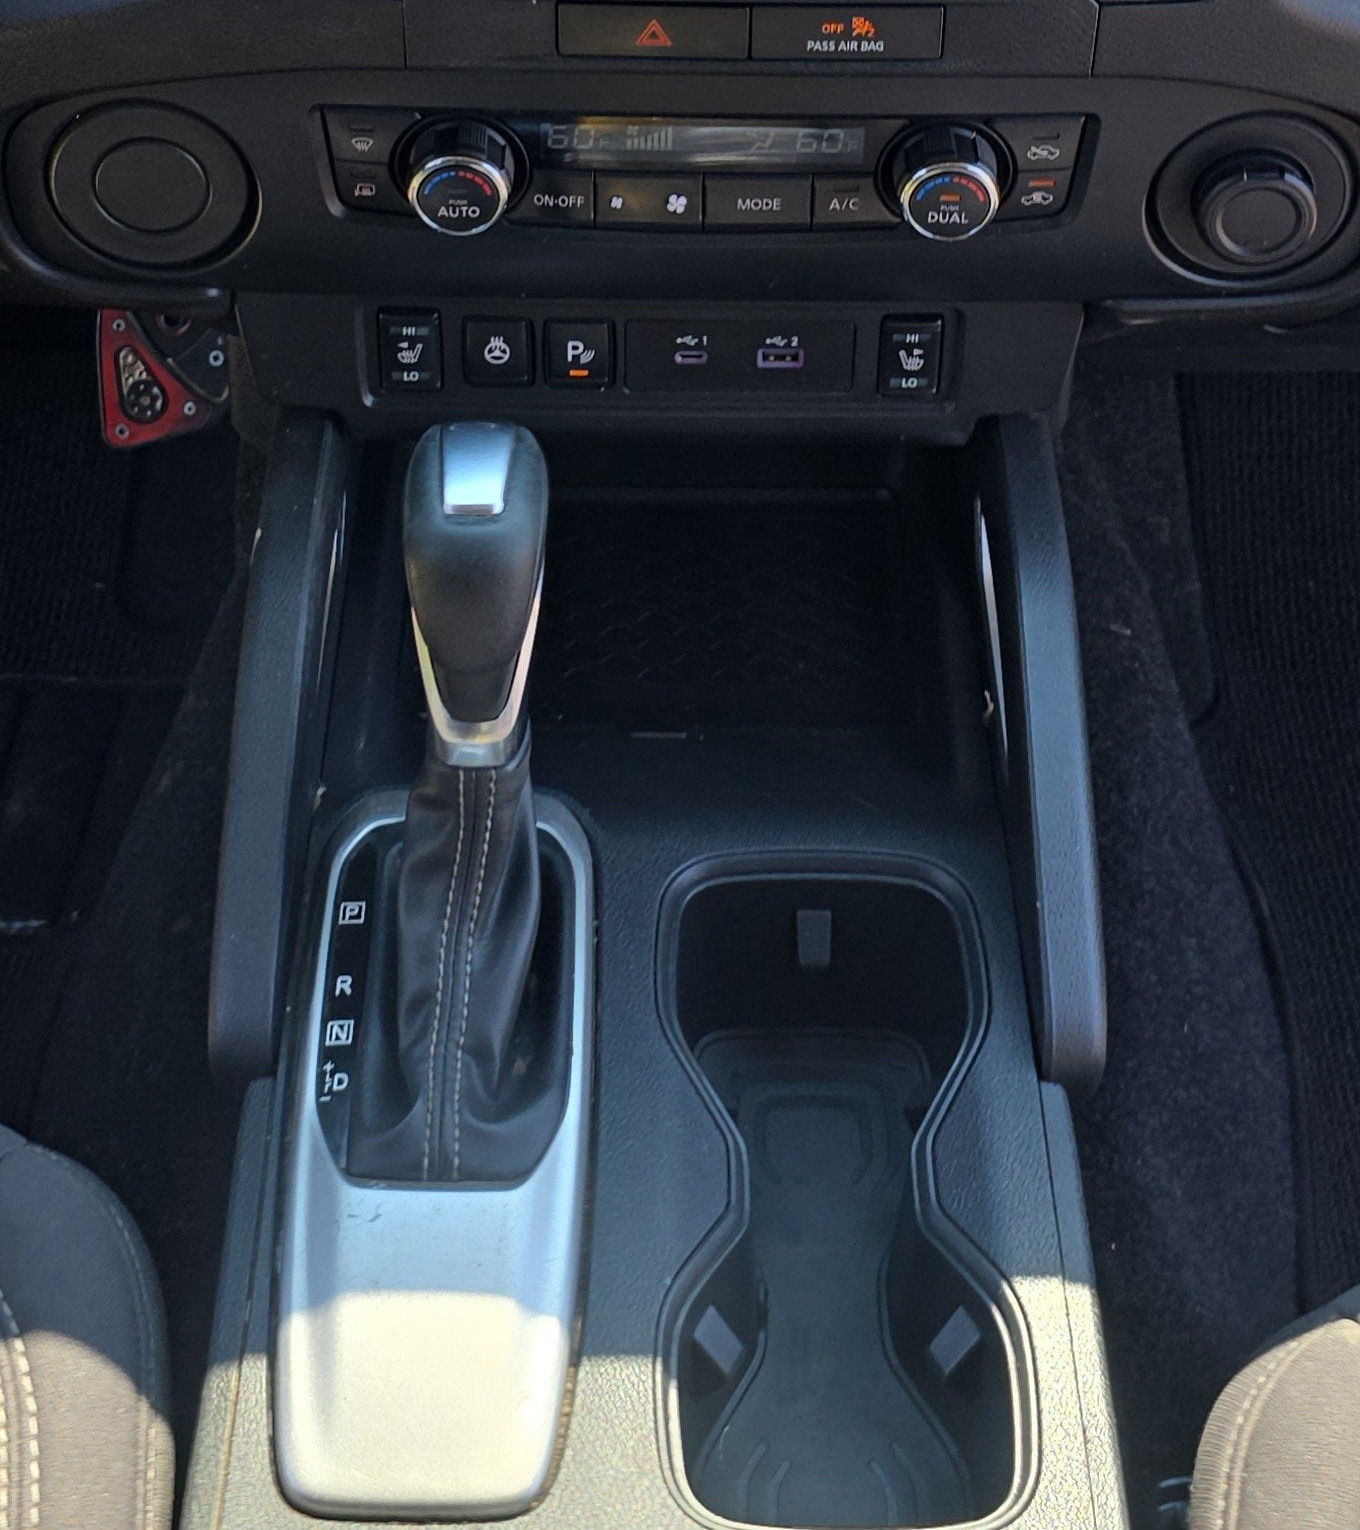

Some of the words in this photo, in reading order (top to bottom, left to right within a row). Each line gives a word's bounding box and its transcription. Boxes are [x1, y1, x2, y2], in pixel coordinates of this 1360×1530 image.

[822, 22, 845, 34] OFF
[807, 40, 836, 51] PASS
[839, 40, 858, 52] AIR
[861, 41, 884, 52] BAG
[737, 198, 782, 211] MODE
[829, 198, 859, 211] A/C
[438, 206, 480, 218] AUTO
[927, 211, 969, 225] DUAL
[402, 327, 416, 335] HI
[702, 335, 708, 346] 1
[791, 336, 799, 347] 2
[905, 333, 919, 343] HI
[567, 341, 584, 362] P
[404, 370, 419, 381] LO
[901, 378, 918, 388] LO
[335, 975, 352, 996] R
[333, 1073, 349, 1090] D
